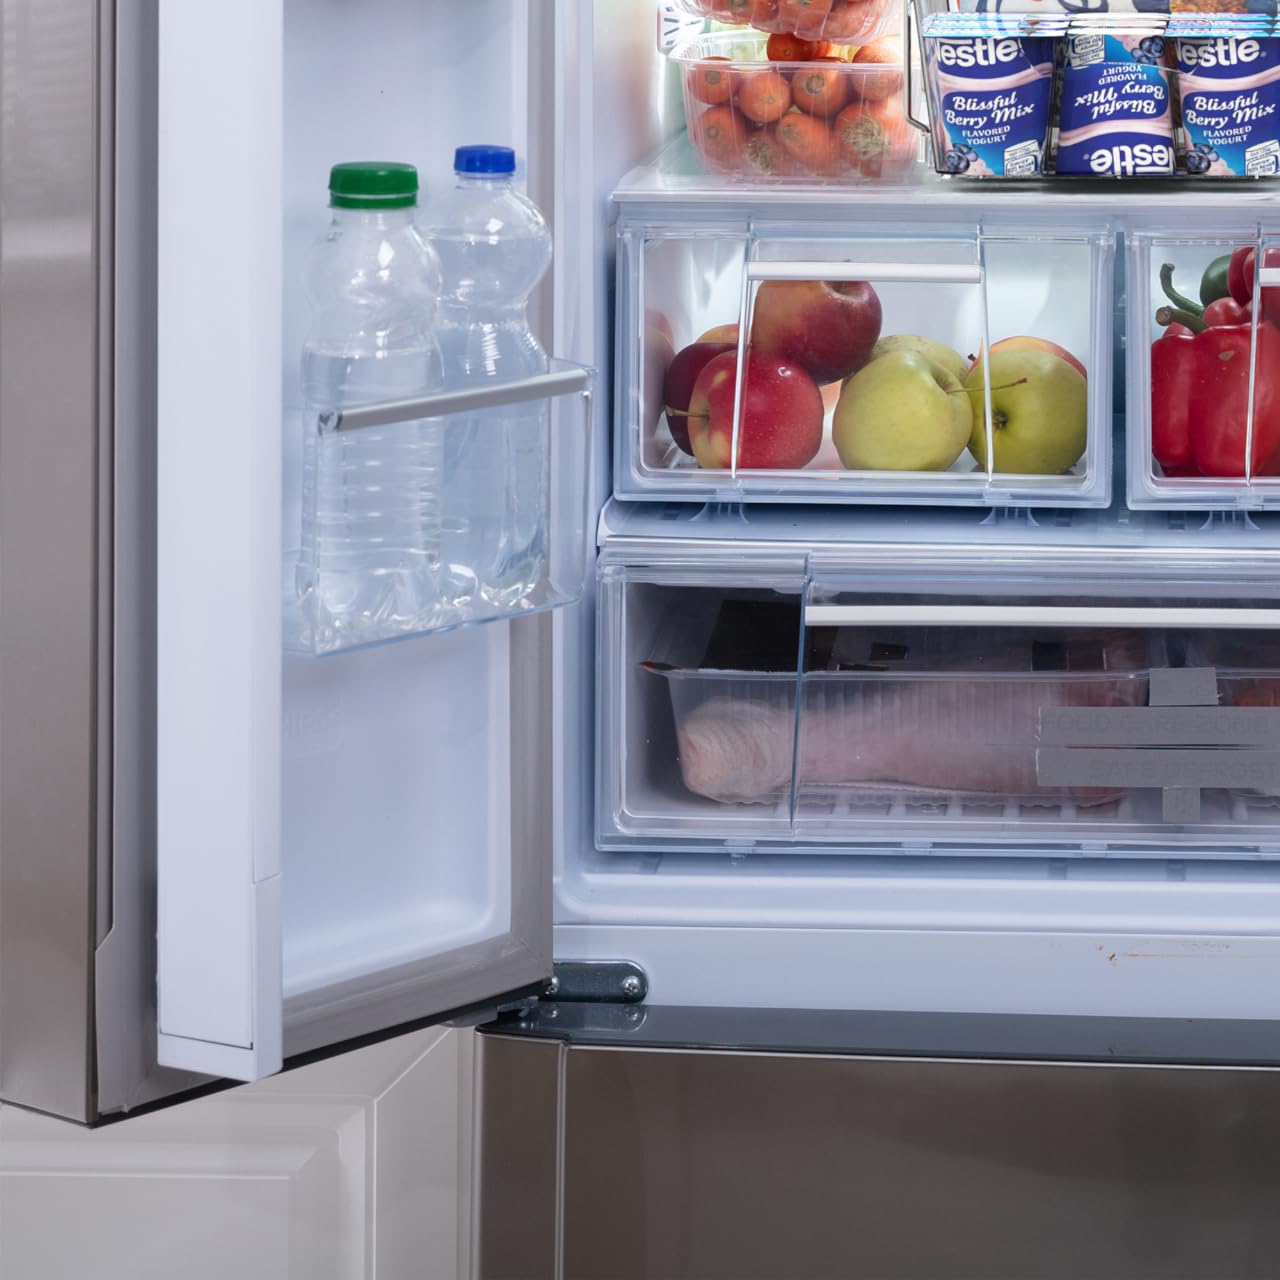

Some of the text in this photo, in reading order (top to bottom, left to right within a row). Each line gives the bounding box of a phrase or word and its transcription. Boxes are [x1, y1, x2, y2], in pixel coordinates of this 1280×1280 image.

[1102, 64, 1143, 76] YOGURT
[1098, 73, 1147, 85] FLAVORED
[952, 91, 1018, 111] Blissful
[1074, 82, 1165, 107] Berry Mix
[1193, 91, 1259, 111] Blissful
[945, 103, 1035, 127] Berry Mix
[1091, 99, 1157, 119] Blissful
[1185, 103, 1276, 128] Berry Mix
[962, 125, 1011, 138] FLAVORED
[1203, 125, 1252, 138] FLAVORED
[966, 135, 1007, 146] YOGURT
[1207, 135, 1248, 146] YOGURT
